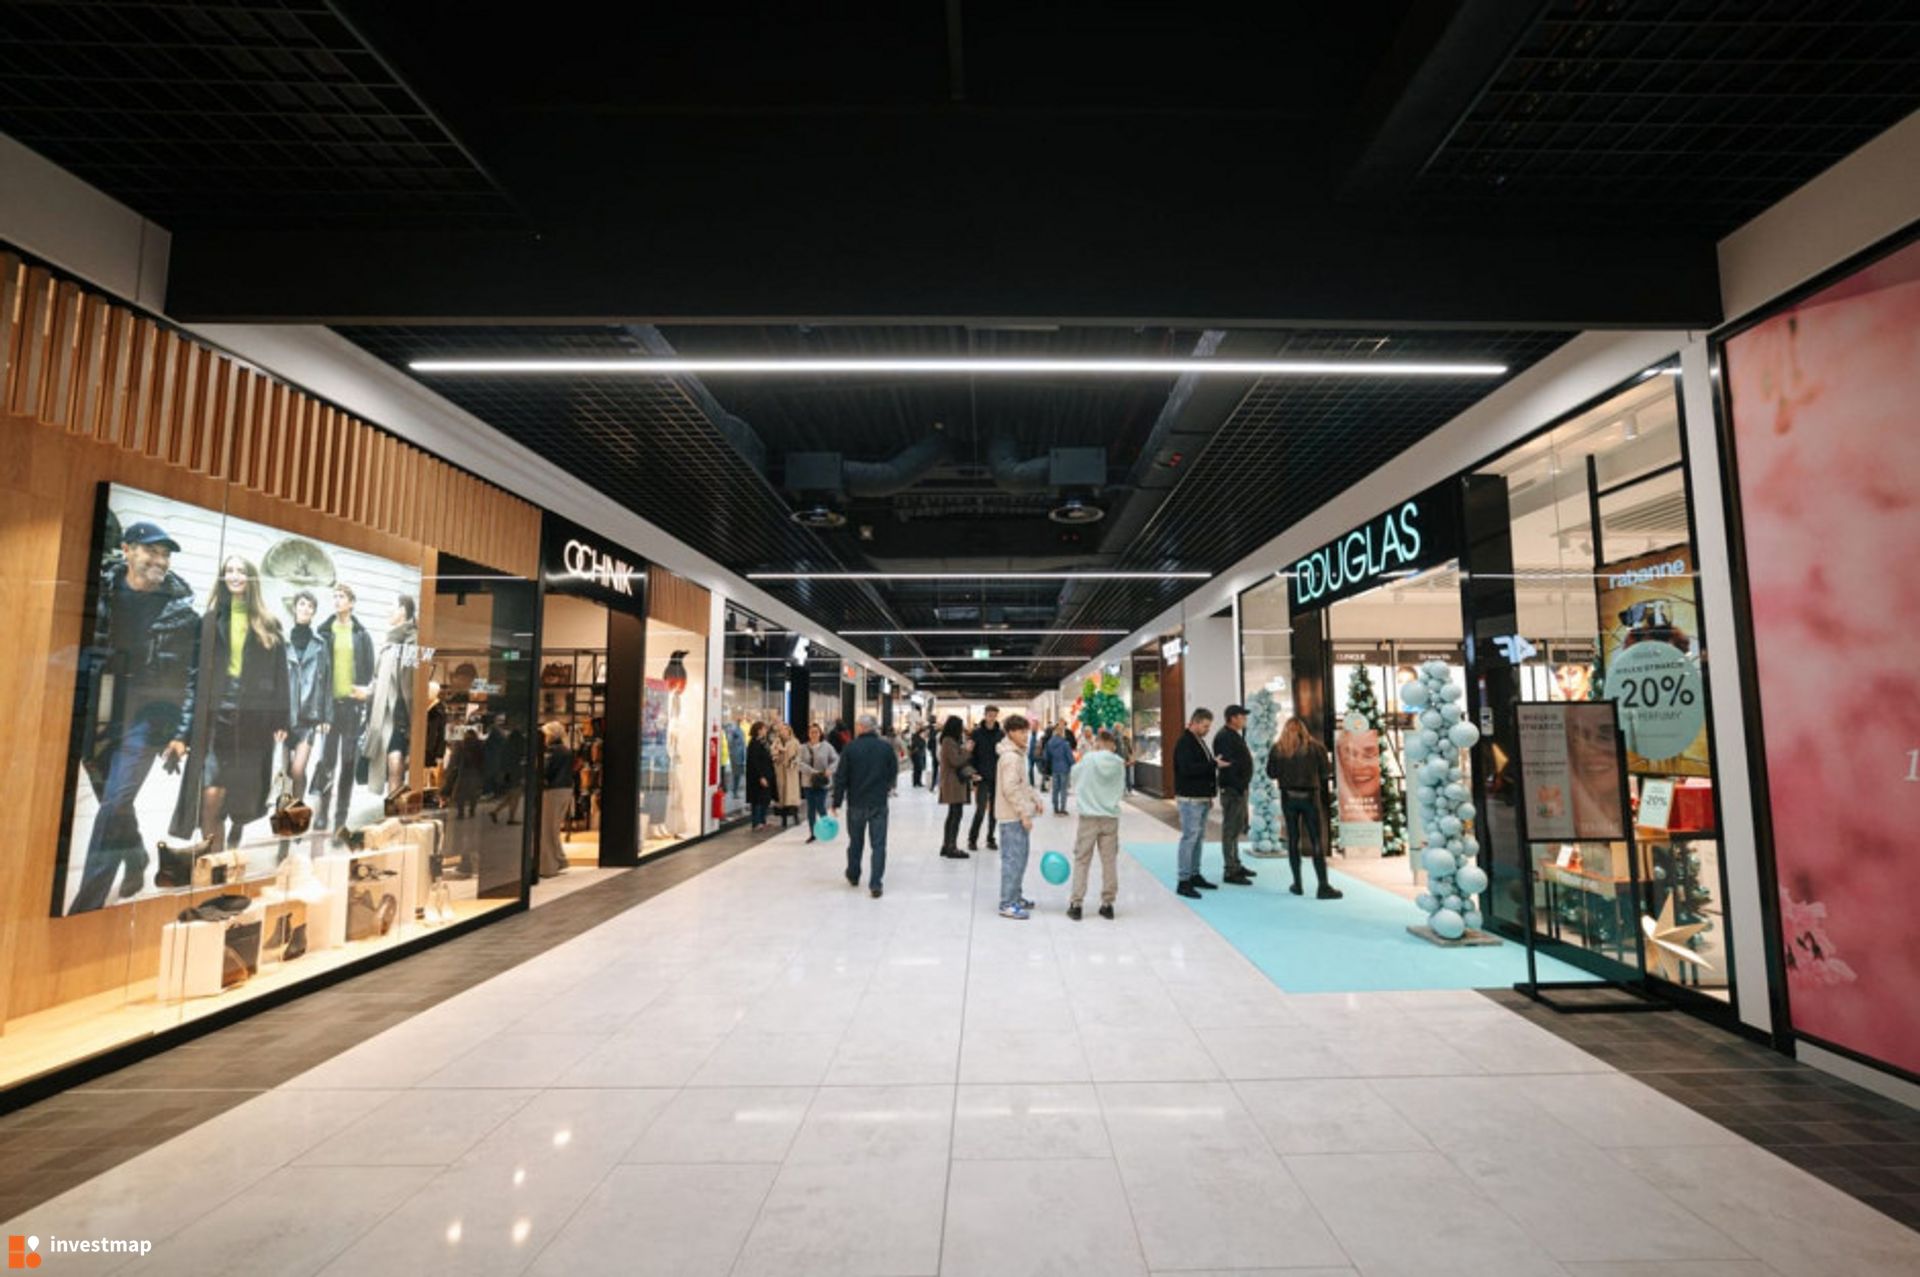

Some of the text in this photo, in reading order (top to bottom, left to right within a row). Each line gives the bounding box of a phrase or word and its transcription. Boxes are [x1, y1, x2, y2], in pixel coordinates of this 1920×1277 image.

[564, 539, 634, 596] OCHNIK
[1297, 502, 1420, 604] DOUGLAS
[1609, 560, 1685, 590] rabanne
